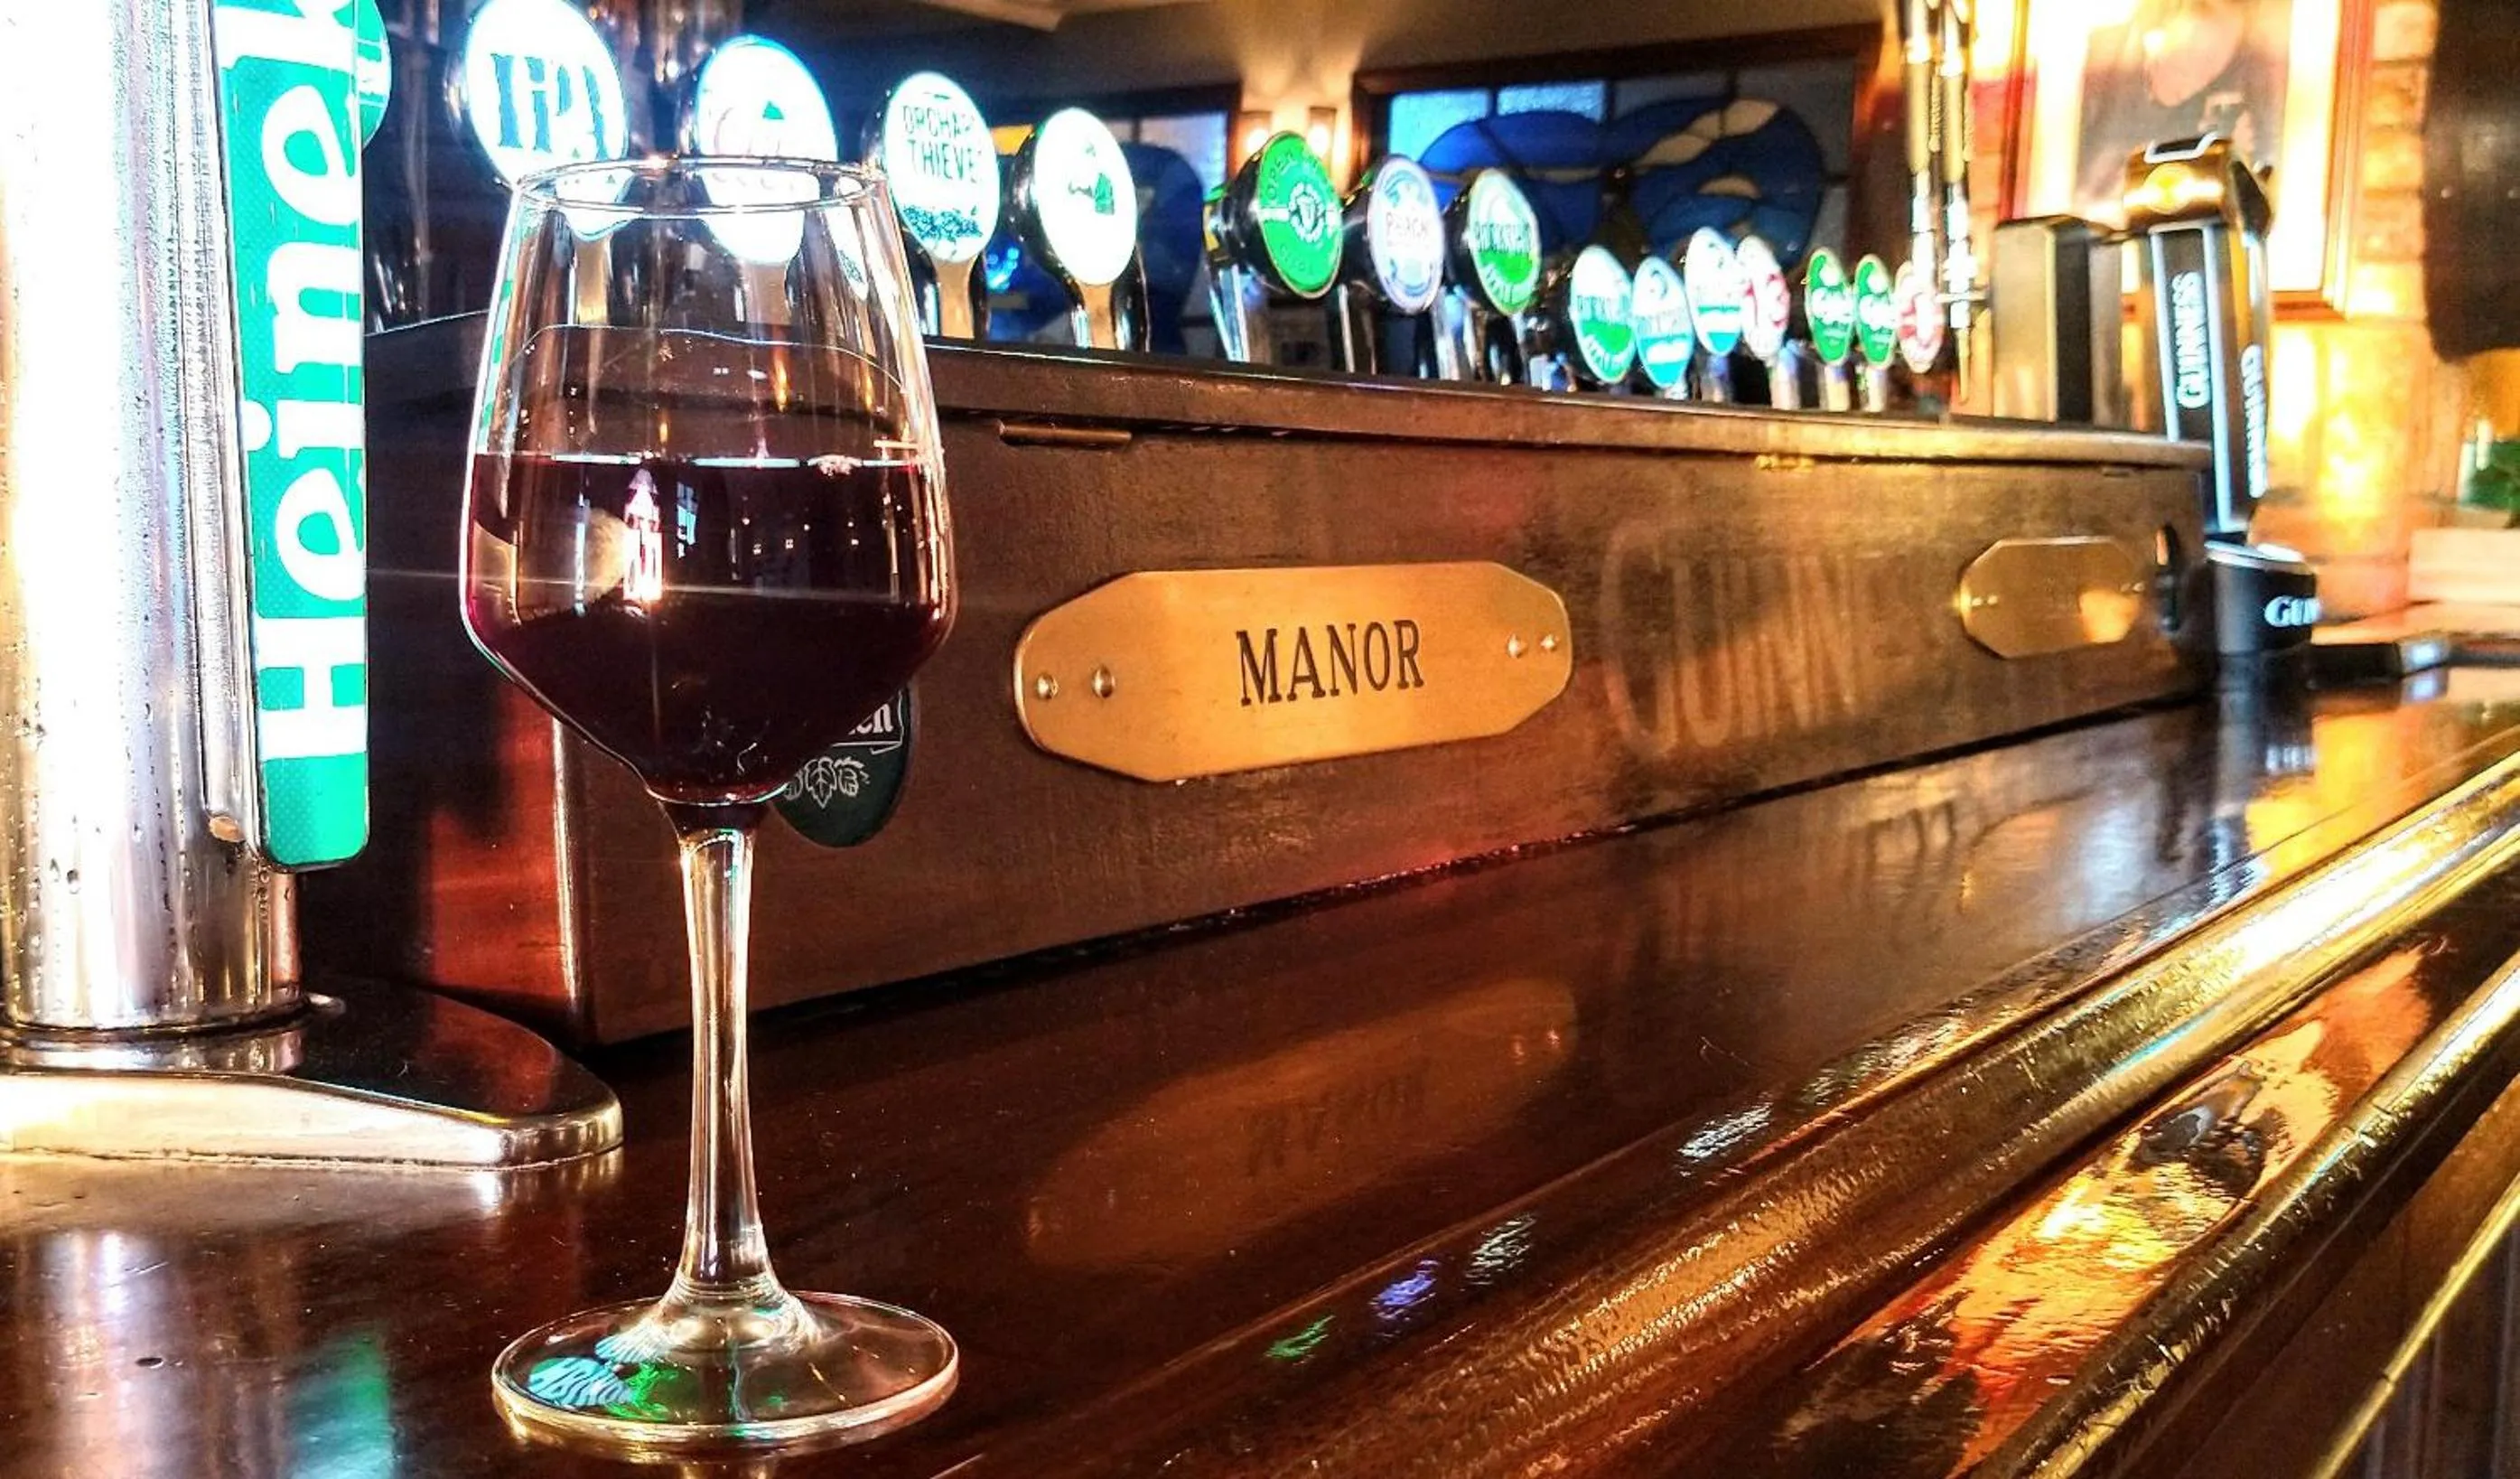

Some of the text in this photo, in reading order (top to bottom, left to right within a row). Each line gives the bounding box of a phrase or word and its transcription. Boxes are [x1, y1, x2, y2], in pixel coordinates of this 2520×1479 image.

[902, 103, 975, 140] ORCHA
[906, 137, 983, 185] THIEVE
[2171, 271, 2212, 408] GUINNESS
[1235, 618, 1425, 707] MANOR
